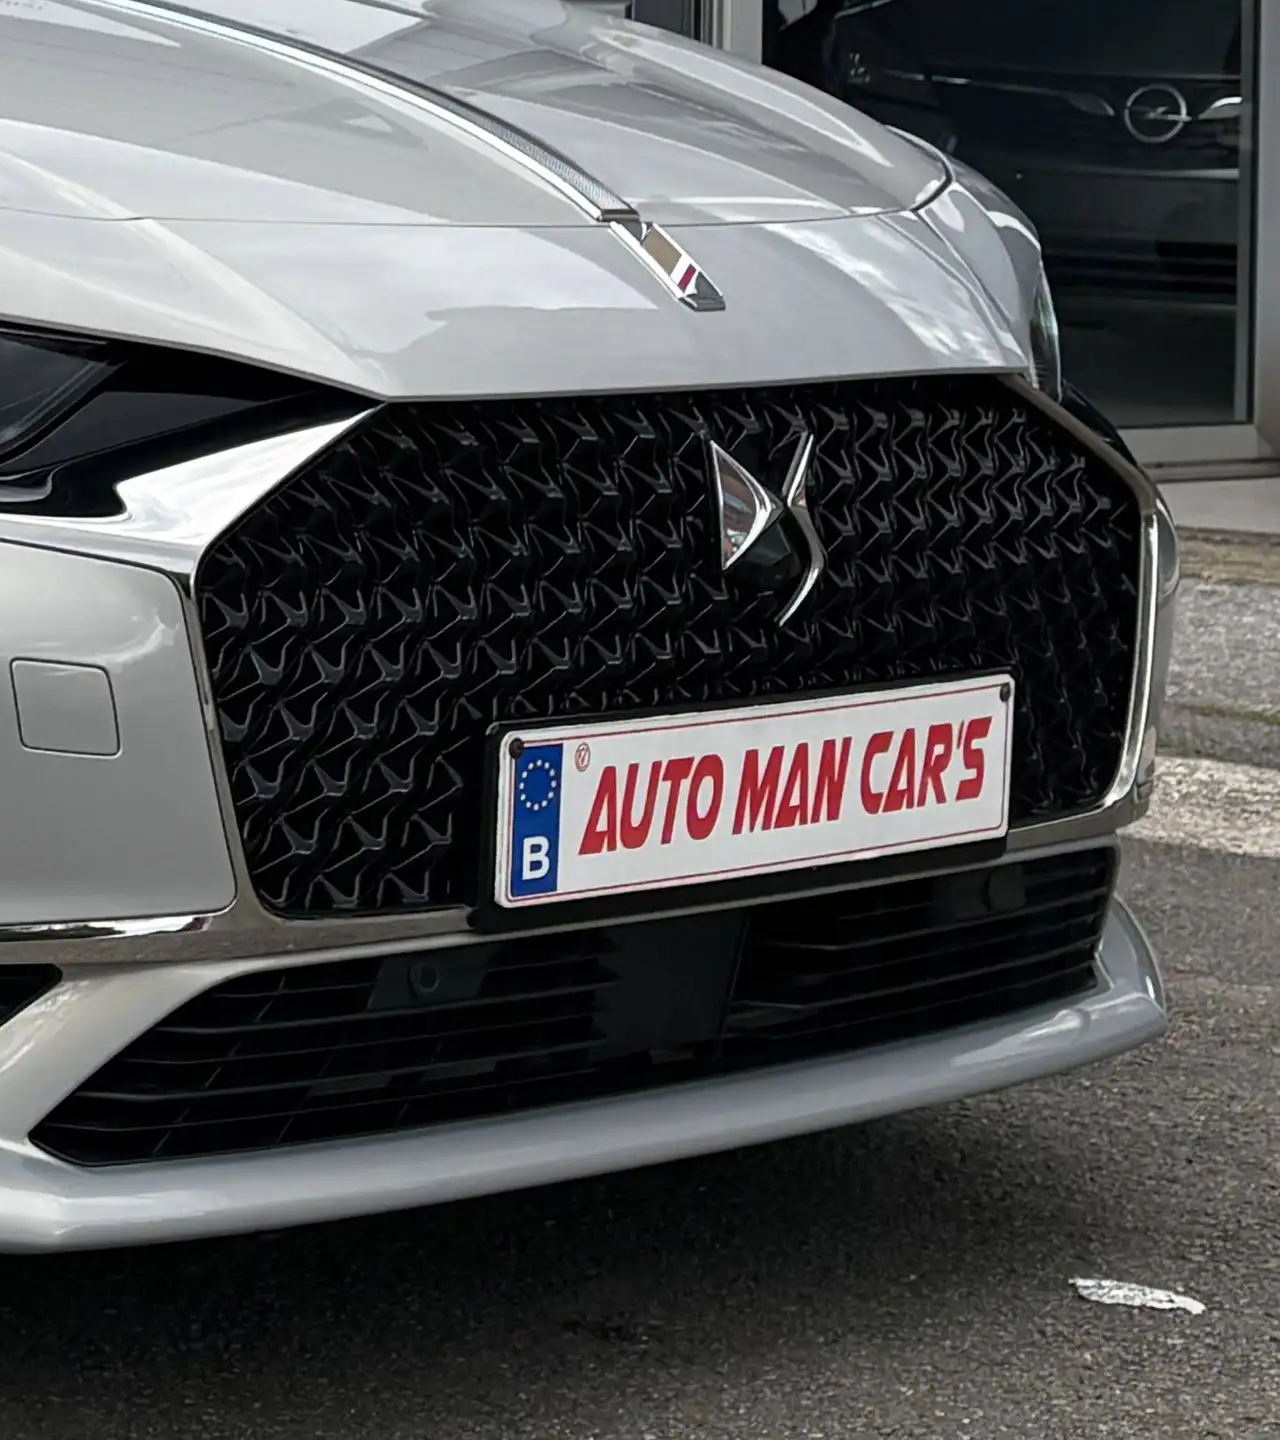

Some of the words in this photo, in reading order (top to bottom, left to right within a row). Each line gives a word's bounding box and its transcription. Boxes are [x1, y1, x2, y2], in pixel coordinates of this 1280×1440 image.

[578, 754, 724, 856] AUTO
[732, 736, 853, 837] MAN
[861, 716, 993, 815] CAR'S
[521, 835, 550, 882] B
